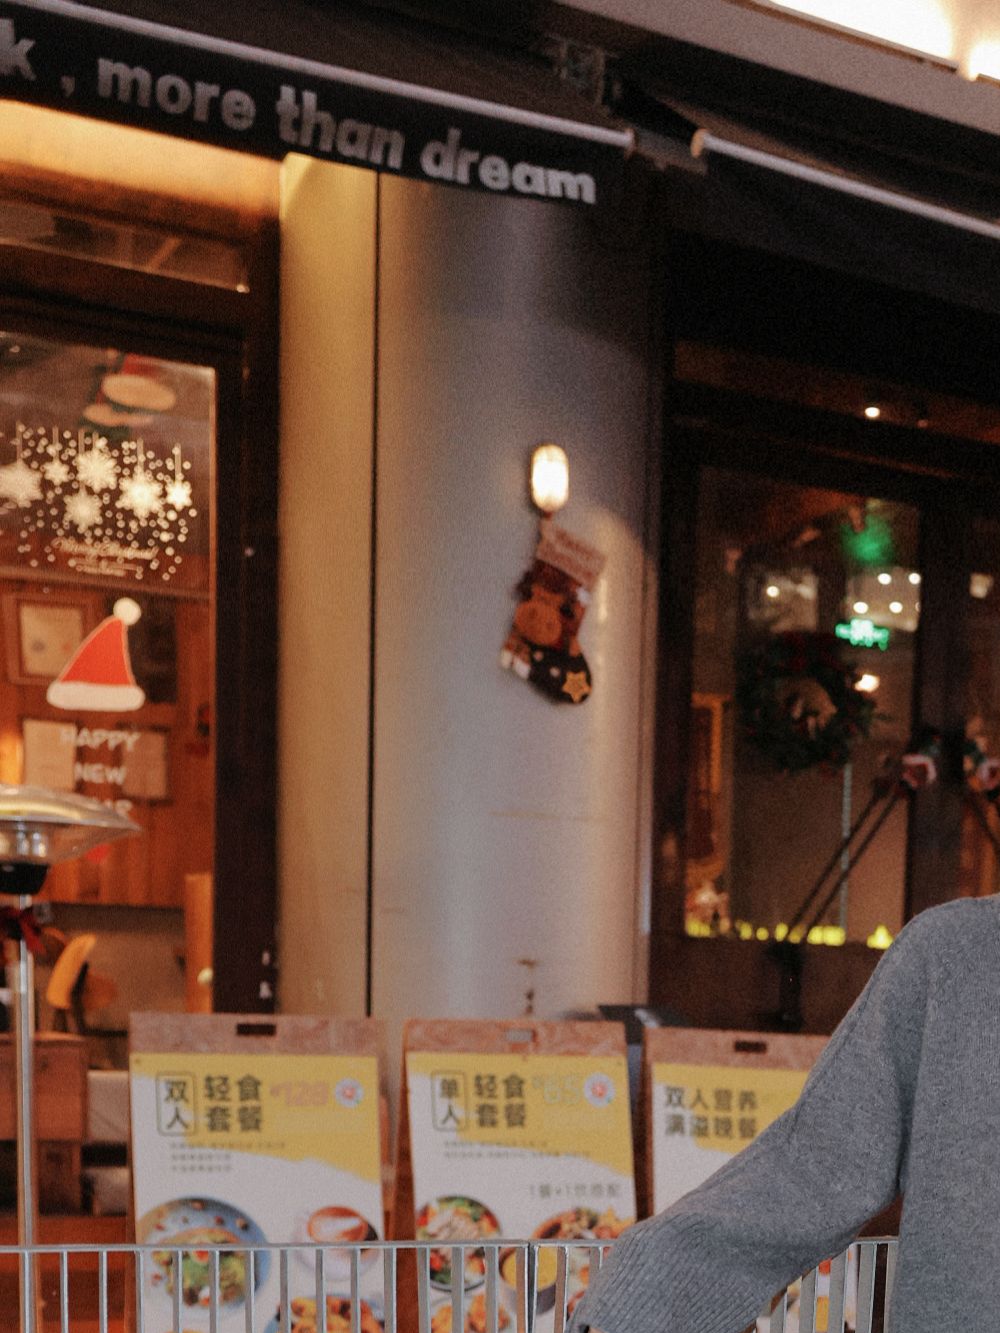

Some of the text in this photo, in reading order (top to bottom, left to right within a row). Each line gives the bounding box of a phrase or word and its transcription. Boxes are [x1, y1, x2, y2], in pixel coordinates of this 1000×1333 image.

[97, 57, 257, 130] more
[276, 85, 405, 169] than
[420, 127, 597, 204] dream
